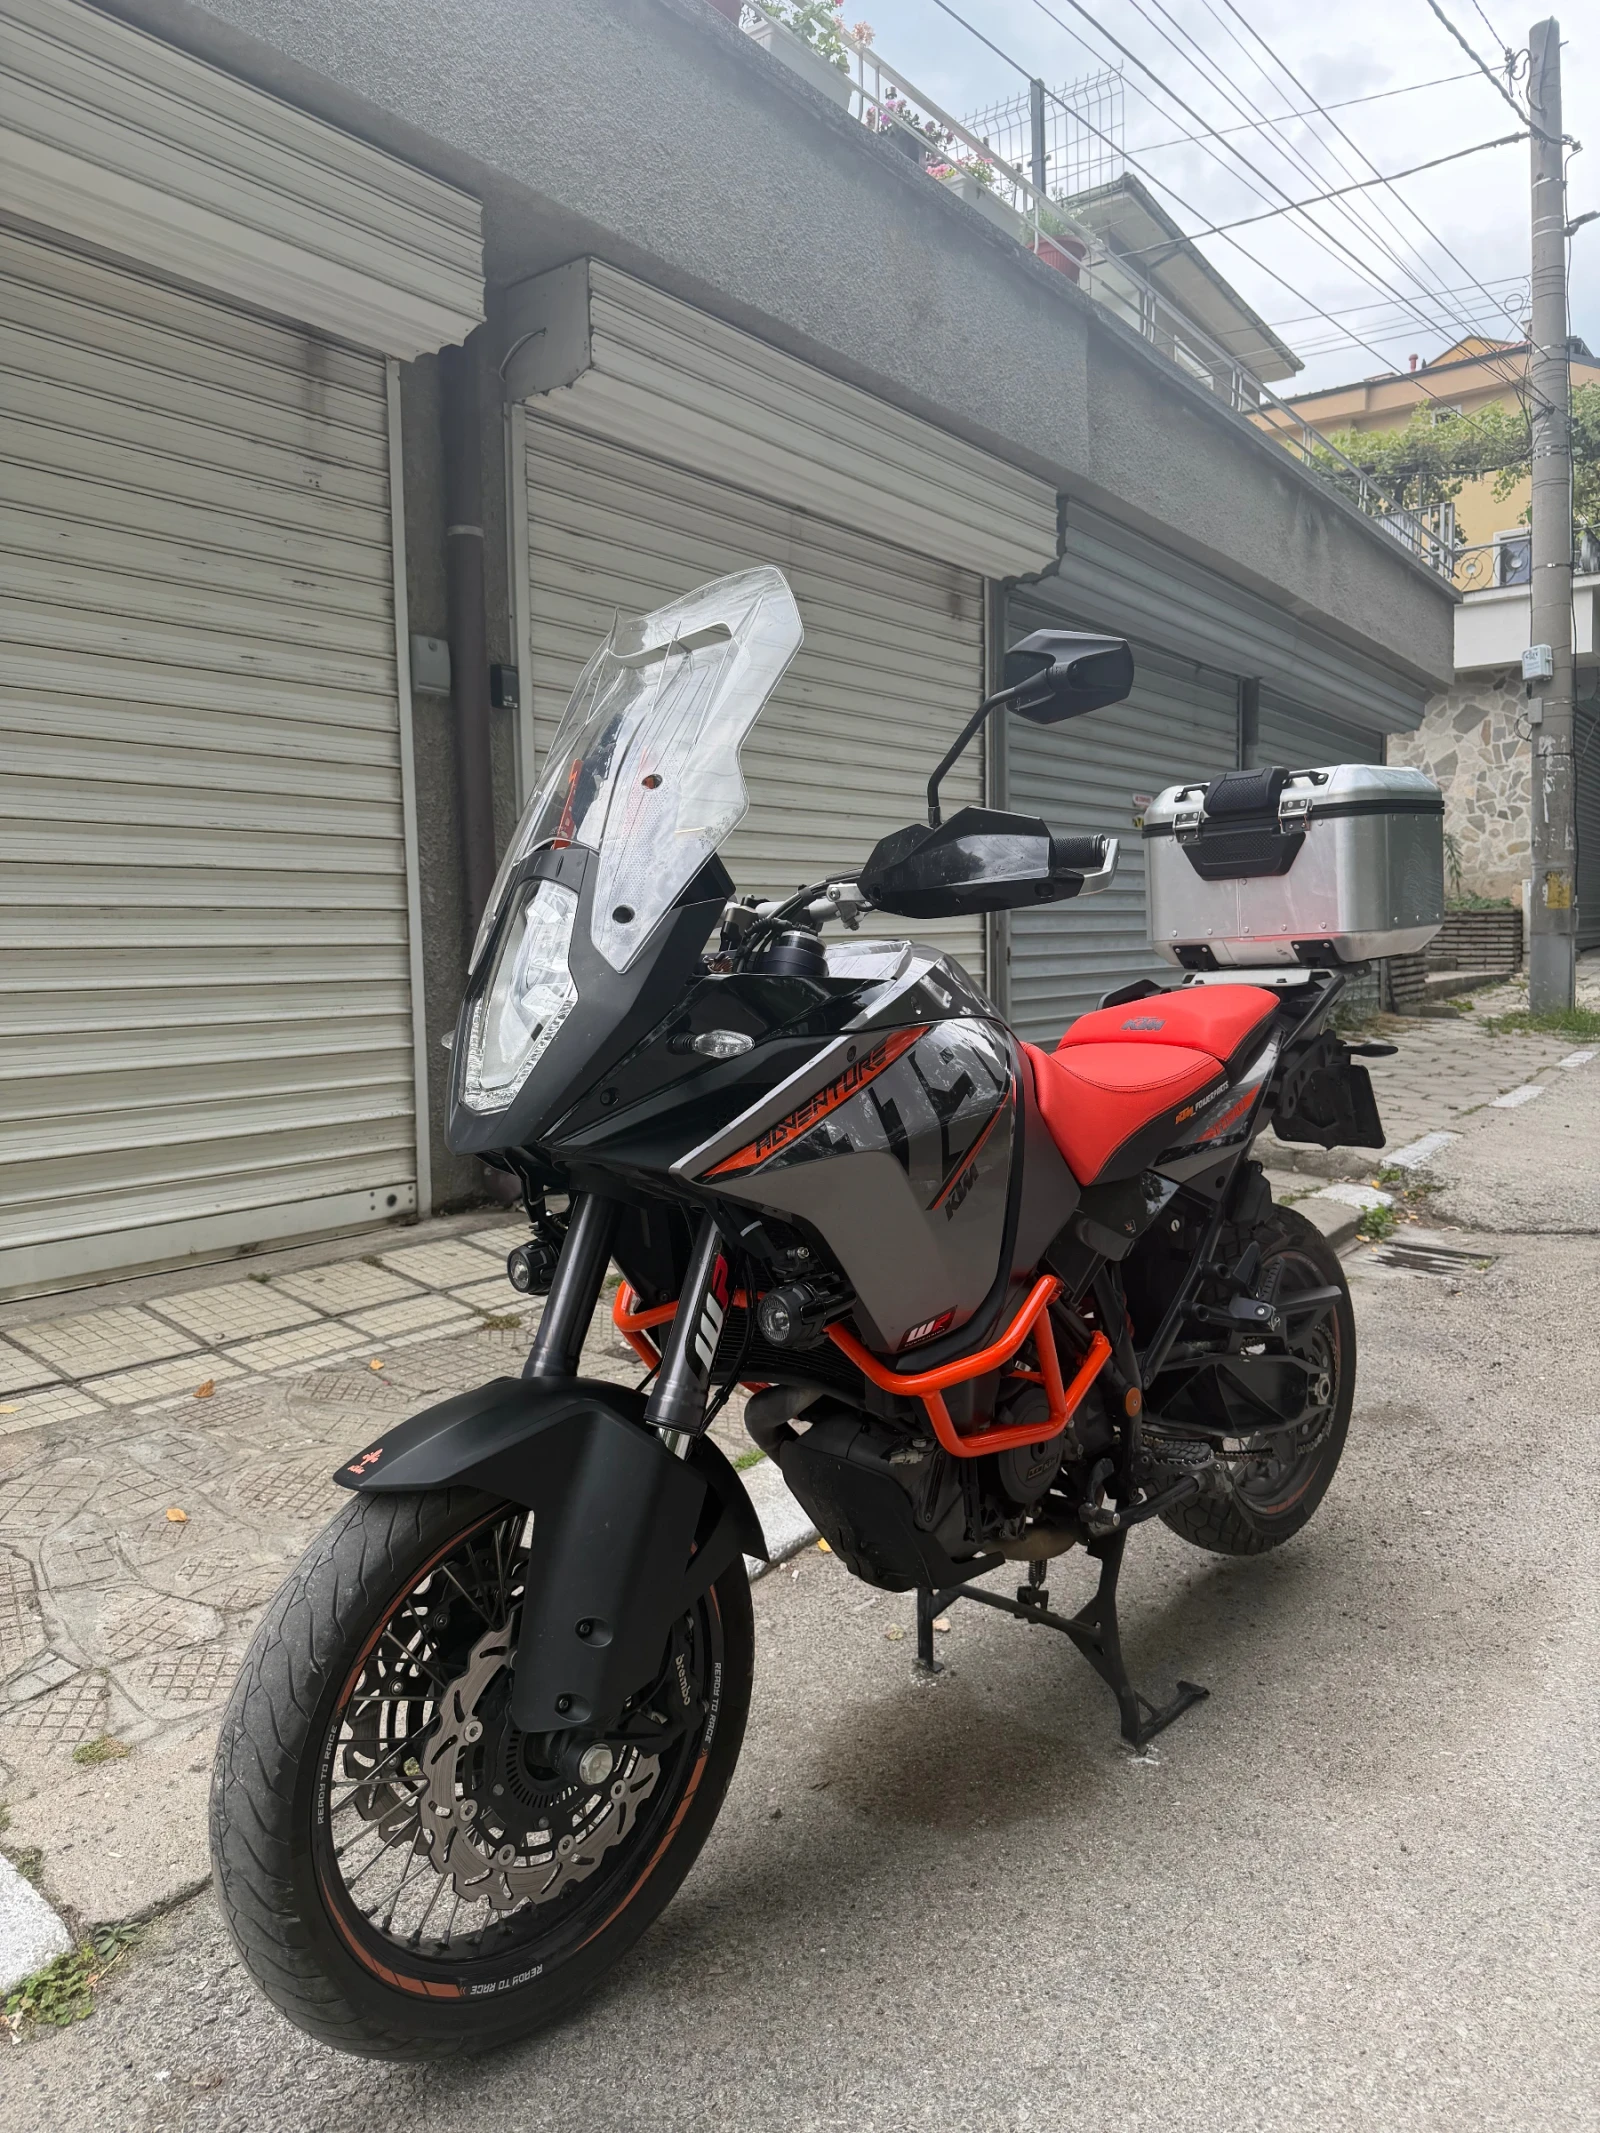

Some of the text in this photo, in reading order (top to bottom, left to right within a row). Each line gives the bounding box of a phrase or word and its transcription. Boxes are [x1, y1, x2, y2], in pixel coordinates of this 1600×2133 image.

[1120, 1016, 1166, 1031] KTM
[755, 1047, 887, 1159] ADVENTURE
[945, 1162, 979, 1222] KTM
[675, 1653, 691, 1706] brembo
[704, 1662, 722, 1744] READY TO RACE
[317, 1724, 338, 1825] READY TO RACE
[470, 1964, 543, 1995] READY TO RACE
